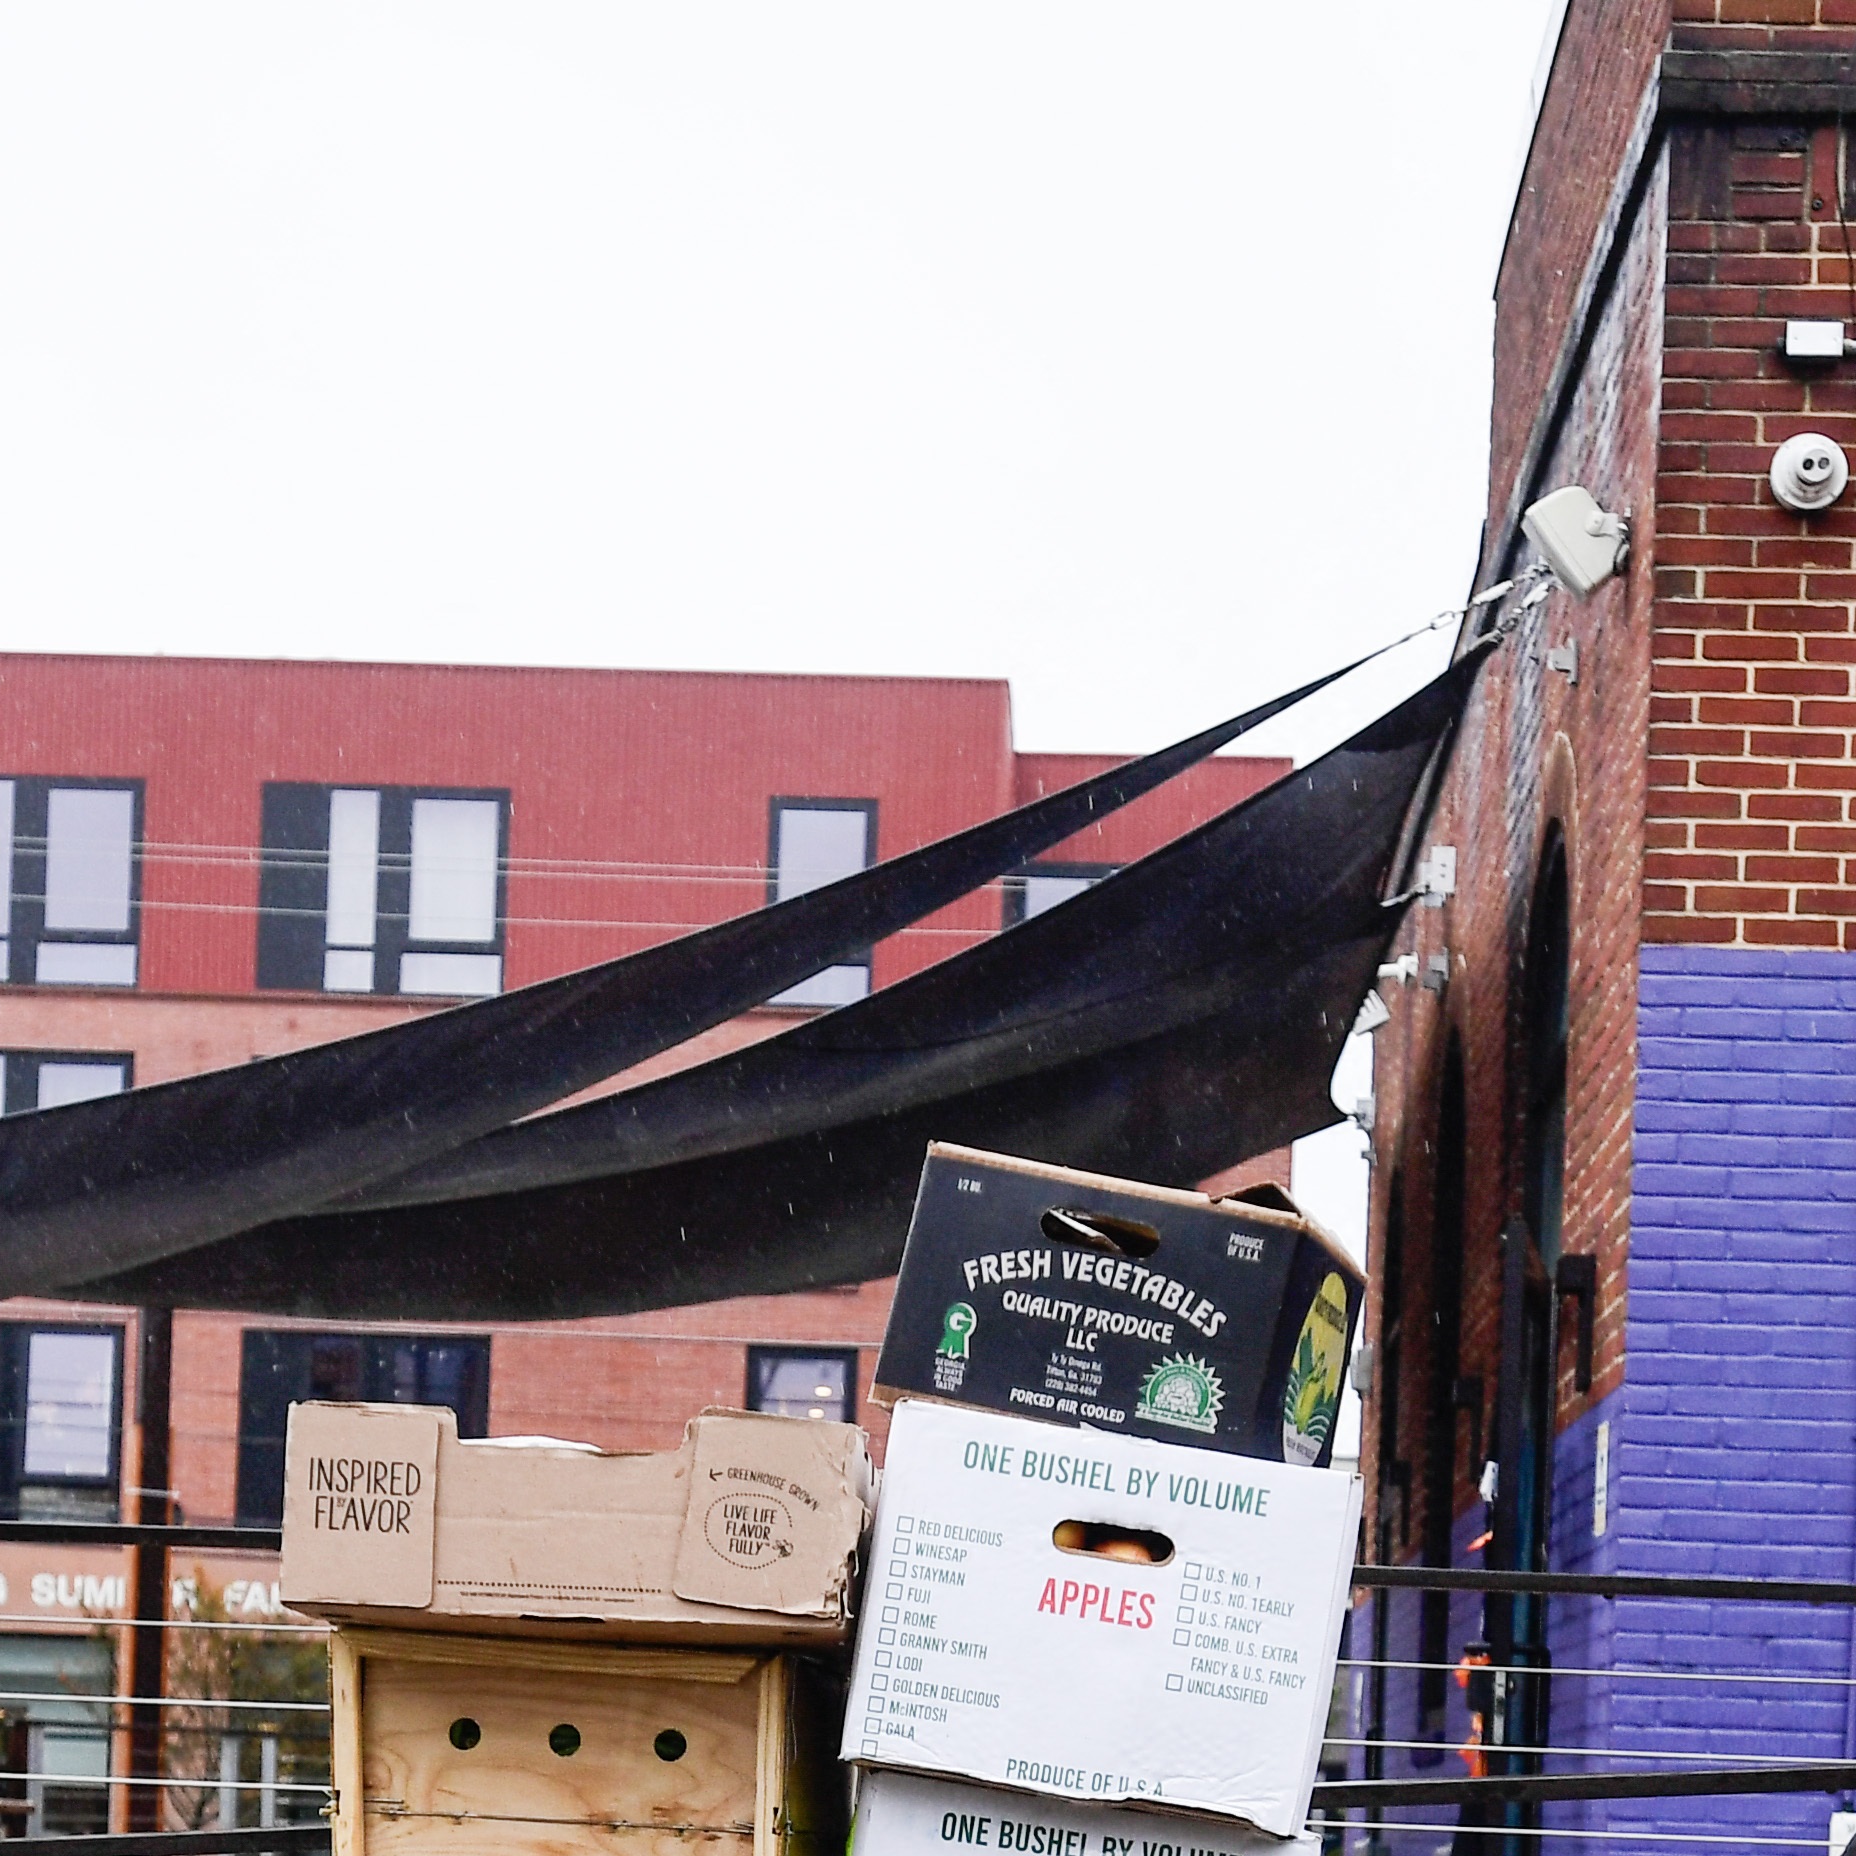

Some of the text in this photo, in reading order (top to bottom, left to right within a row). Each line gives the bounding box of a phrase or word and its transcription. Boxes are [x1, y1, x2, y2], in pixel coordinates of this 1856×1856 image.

[1227, 1246, 1238, 1258] OF
[1229, 1232, 1265, 1250] PRODUCE
[963, 1249, 1228, 1338] FRESH VEGETABLES
[1002, 1289, 1175, 1344] QUALITY PRODUCE
[1065, 1327, 1099, 1352] LLC
[943, 1374, 963, 1386] GOOD
[1009, 1387, 1055, 1411] FORCED
[1056, 1398, 1078, 1415] AIR
[1079, 1402, 1126, 1424] COOLED
[309, 1457, 421, 1496] INSPIRED
[727, 1467, 821, 1511] GREENHOUSE GROWN
[963, 1441, 1271, 1517] ONE BUSHEL BY VOLUME
[315, 1495, 411, 1534] FLAVOR
[723, 1503, 777, 1524] LIVE LIFE
[725, 1520, 770, 1540] FLAVOR
[918, 1520, 1004, 1547] RED DELICIOUS
[729, 1537, 763, 1556] FULLY
[915, 1541, 968, 1563] WINESAP
[910, 1564, 966, 1587] STAYMAN
[1205, 1566, 1262, 1590] U.S. NO. 1
[907, 1586, 931, 1604] FUJI
[1037, 1577, 1156, 1631] APPLES
[1202, 1588, 1224, 1606] U.S.
[1228, 1593, 1248, 1610] NO.
[903, 1610, 938, 1630] ROME
[1198, 1611, 1263, 1635] U.S. FANCY
[900, 1632, 988, 1660] GRANNY SMITH
[1194, 1633, 1298, 1664] COMB. U.S. EXTRA
[896, 1654, 923, 1672] LODI
[1190, 1656, 1306, 1690] FANCY & U.S. FANCY
[892, 1678, 1001, 1709] GOLDEN DELICIOUS
[1187, 1678, 1268, 1706] UNCLASSIFIED
[889, 1700, 948, 1723] McINTOSH
[885, 1722, 915, 1741] GALA
[1006, 1758, 1168, 1798] PRODUCE OF US.A.
[941, 1812, 991, 1846] ONE
